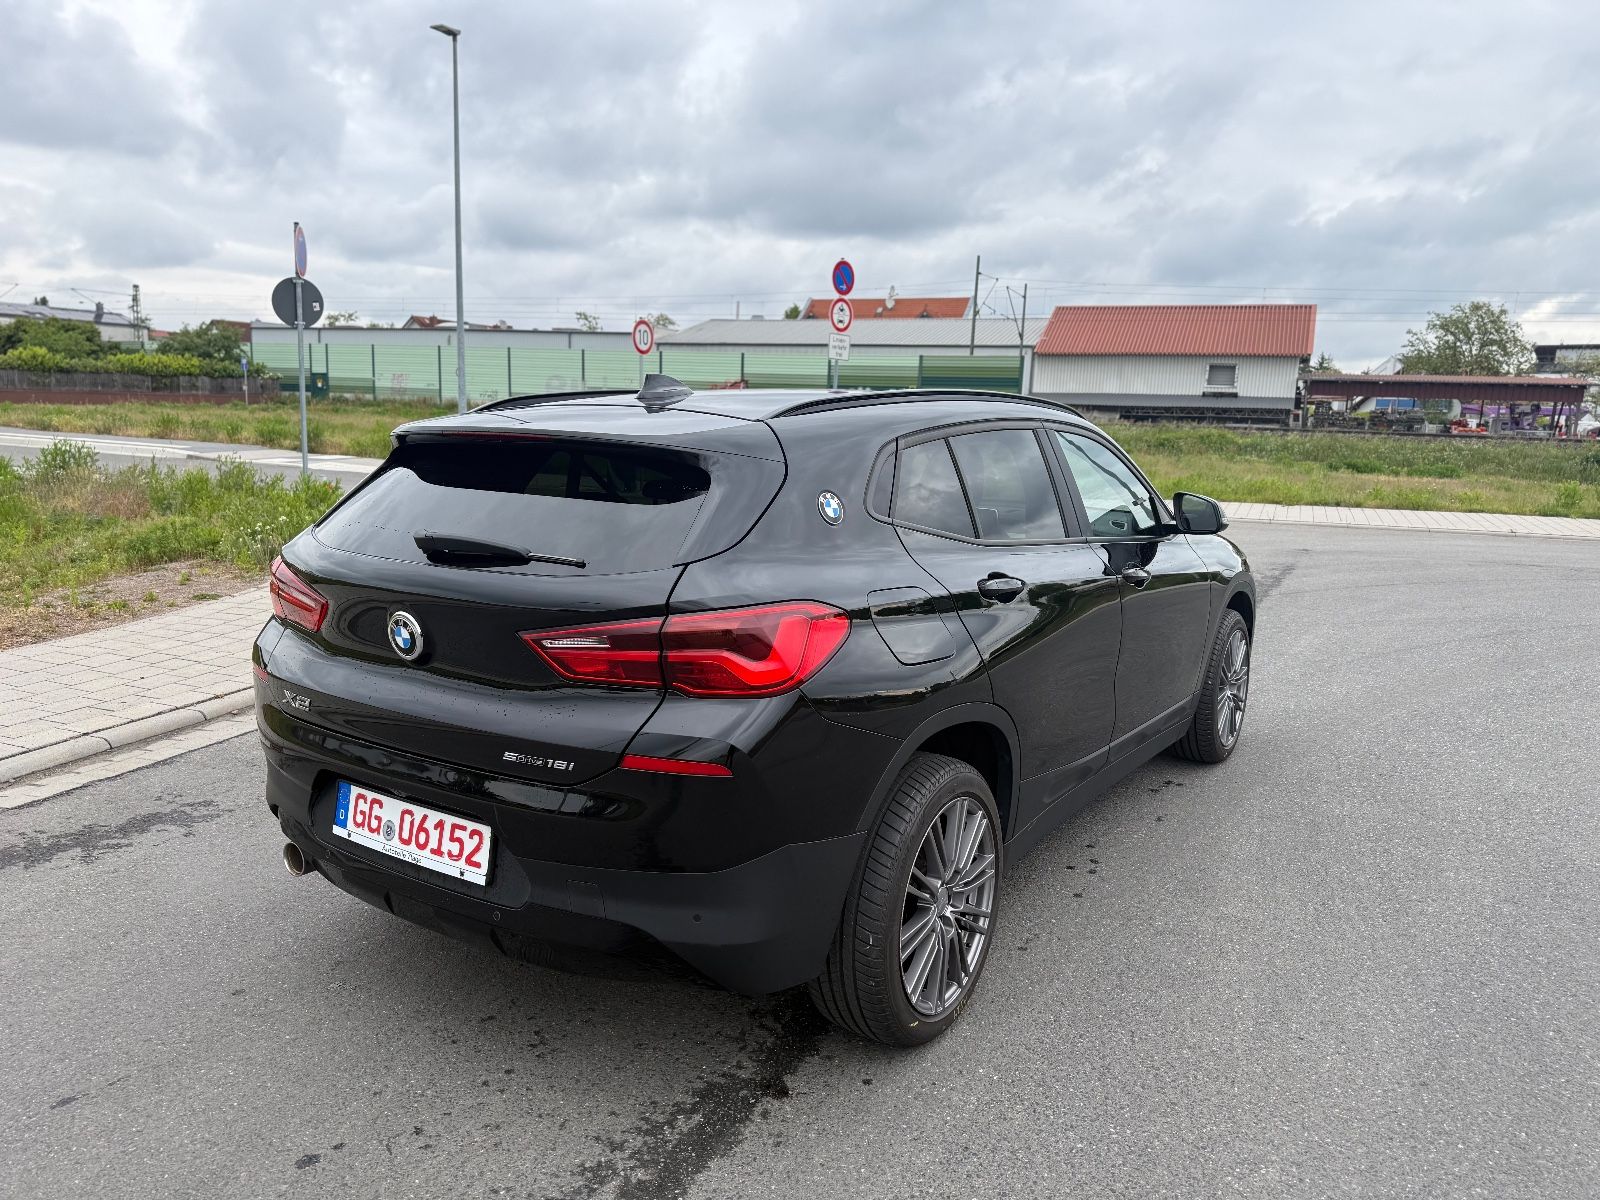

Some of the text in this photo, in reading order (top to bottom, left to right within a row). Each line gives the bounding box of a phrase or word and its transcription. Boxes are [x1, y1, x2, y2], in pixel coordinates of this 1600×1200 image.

[638, 329, 649, 345] 10
[282, 689, 311, 712] X2
[352, 792, 484, 869] GG 06152
